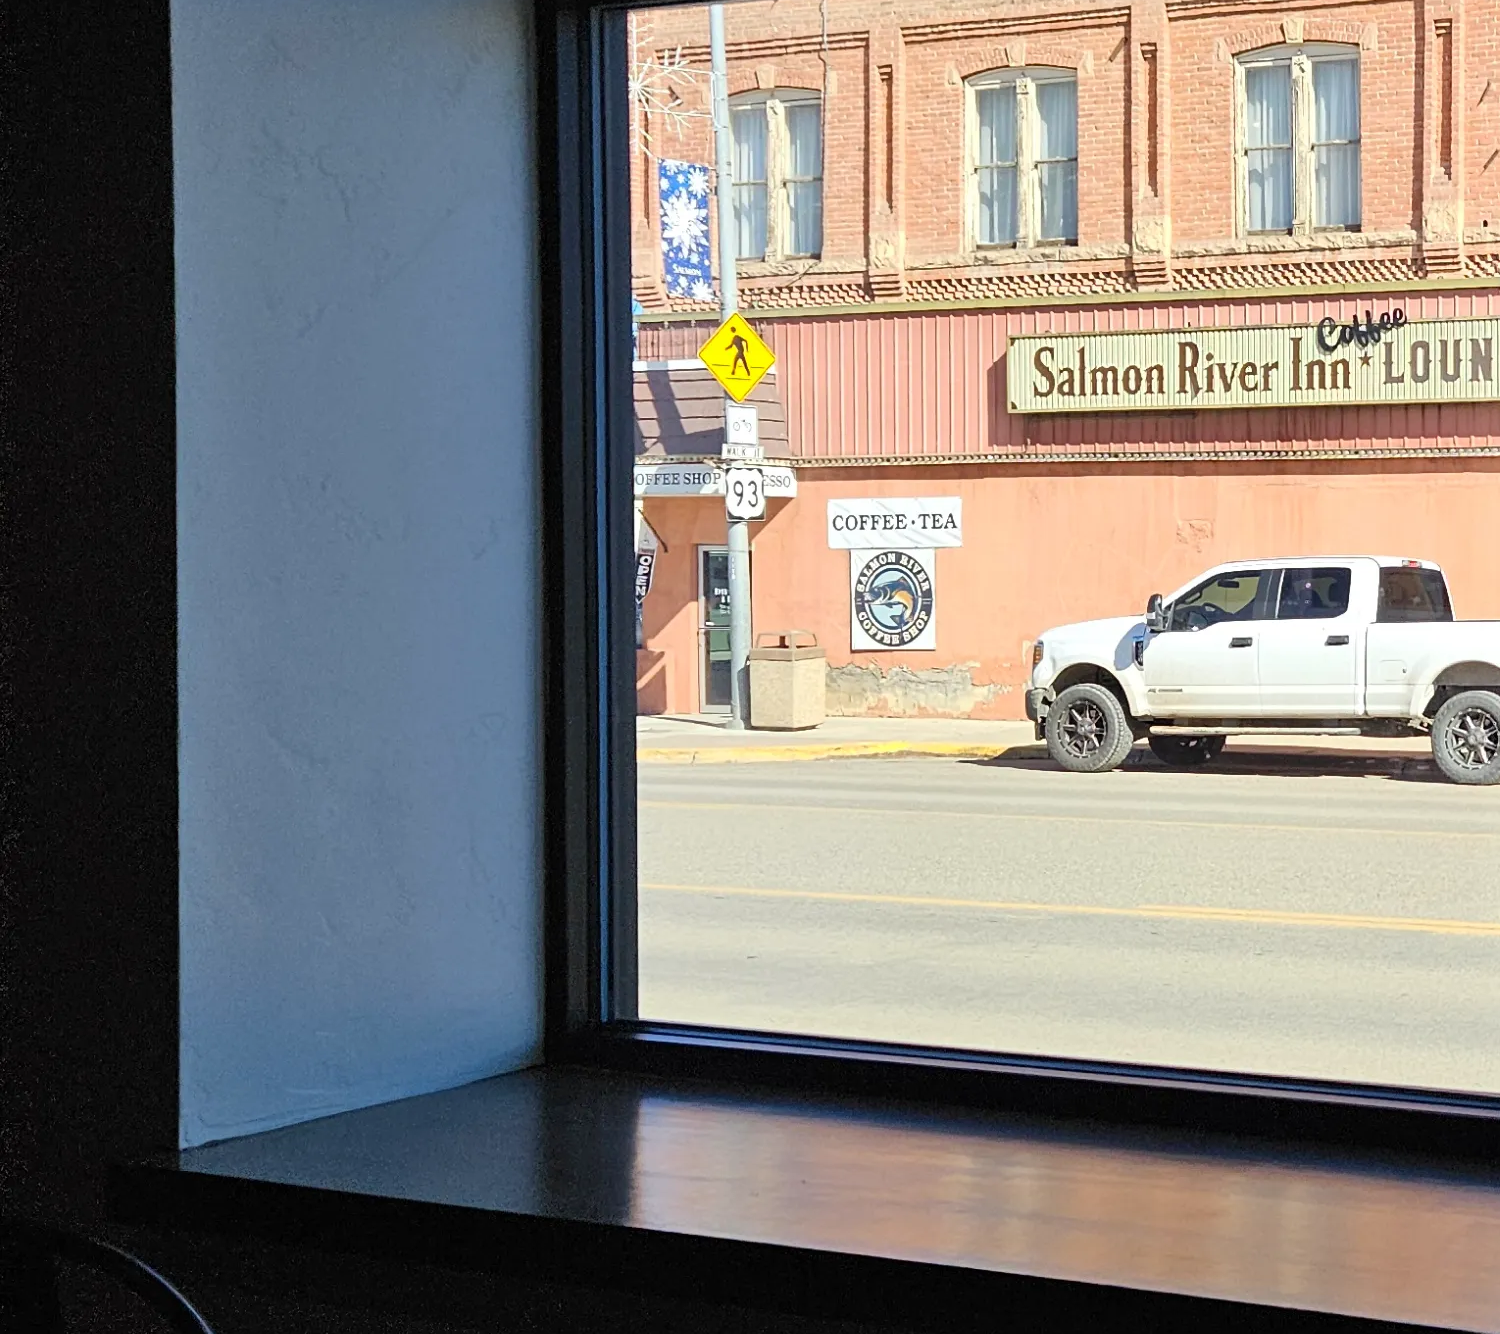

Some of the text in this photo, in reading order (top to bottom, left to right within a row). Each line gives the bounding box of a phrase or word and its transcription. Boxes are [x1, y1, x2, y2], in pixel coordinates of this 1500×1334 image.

[1317, 308, 1407, 353] Coffee
[1033, 346, 1166, 398] Salmon
[1176, 341, 1279, 400] River
[1290, 336, 1352, 391] Inn
[635, 472, 680, 486] OFFEE
[683, 471, 721, 485] SHOP
[733, 480, 758, 508] 93
[832, 512, 958, 531] COFFEE TEA
[635, 555, 653, 597] OPEN
[857, 552, 930, 593] SALMON RIVER
[858, 610, 930, 645] COFFEE SHOP
